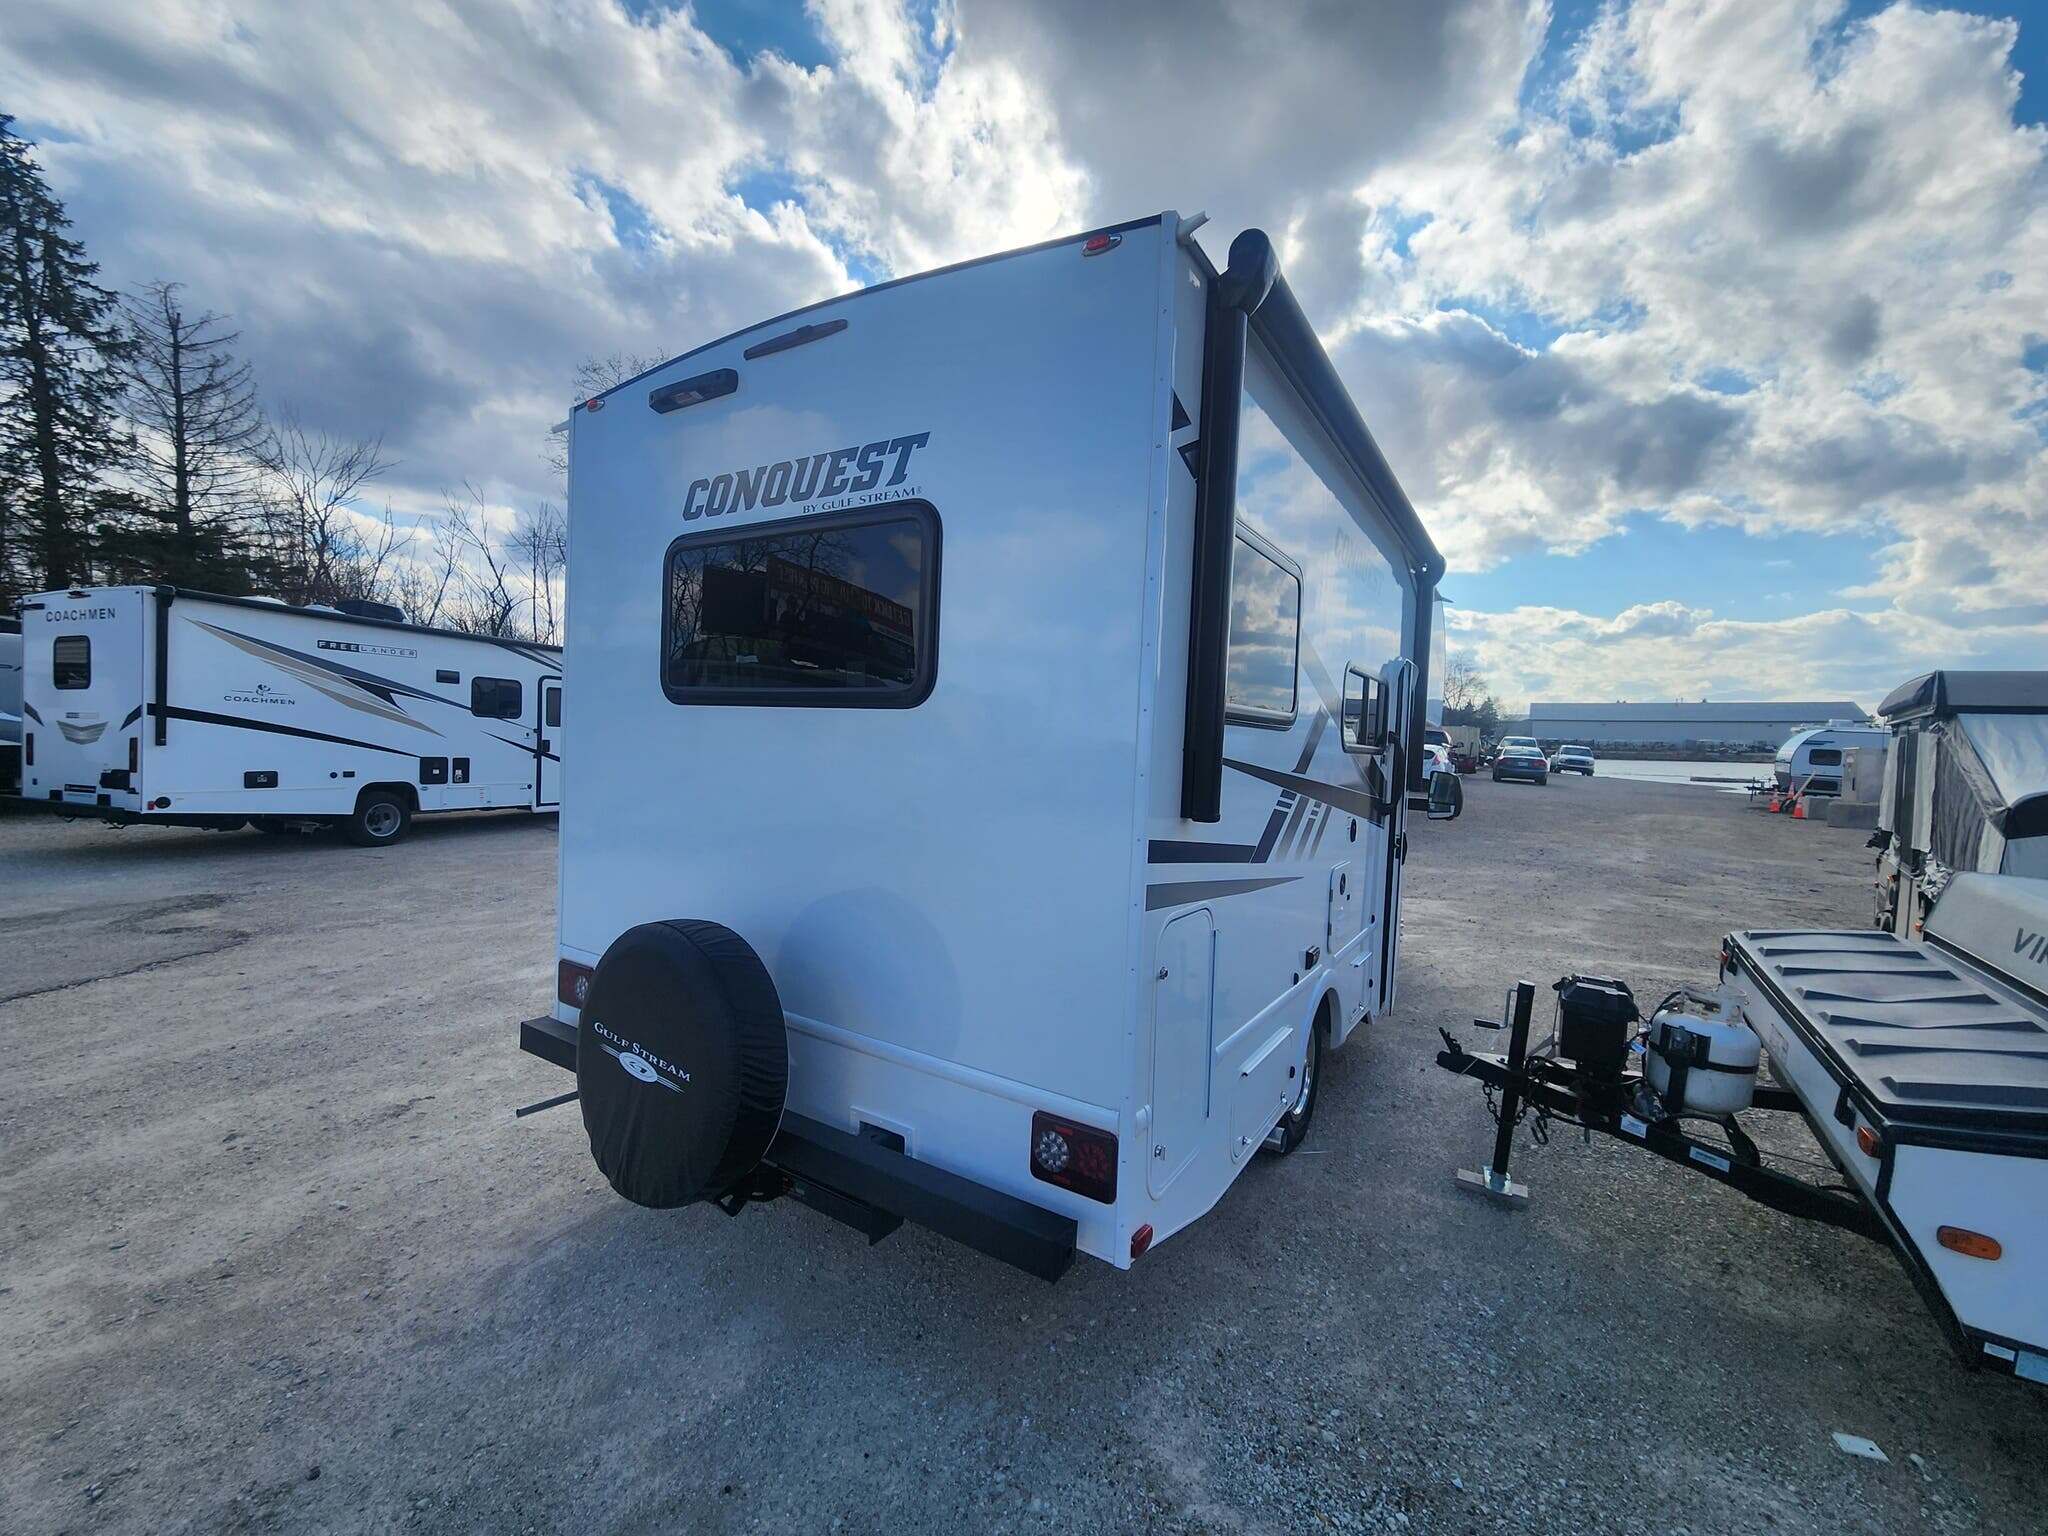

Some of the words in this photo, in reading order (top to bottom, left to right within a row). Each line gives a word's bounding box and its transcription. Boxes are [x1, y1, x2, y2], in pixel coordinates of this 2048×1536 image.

[682, 431, 932, 522] CONQUEST
[802, 503, 820, 514] BY
[821, 497, 854, 511] GULF
[45, 607, 116, 622] COACHMEN
[318, 641, 416, 657] FREELANDER
[223, 695, 296, 705] COACHMEN
[594, 1022, 631, 1048] GULF
[632, 1042, 691, 1082] STREAM
